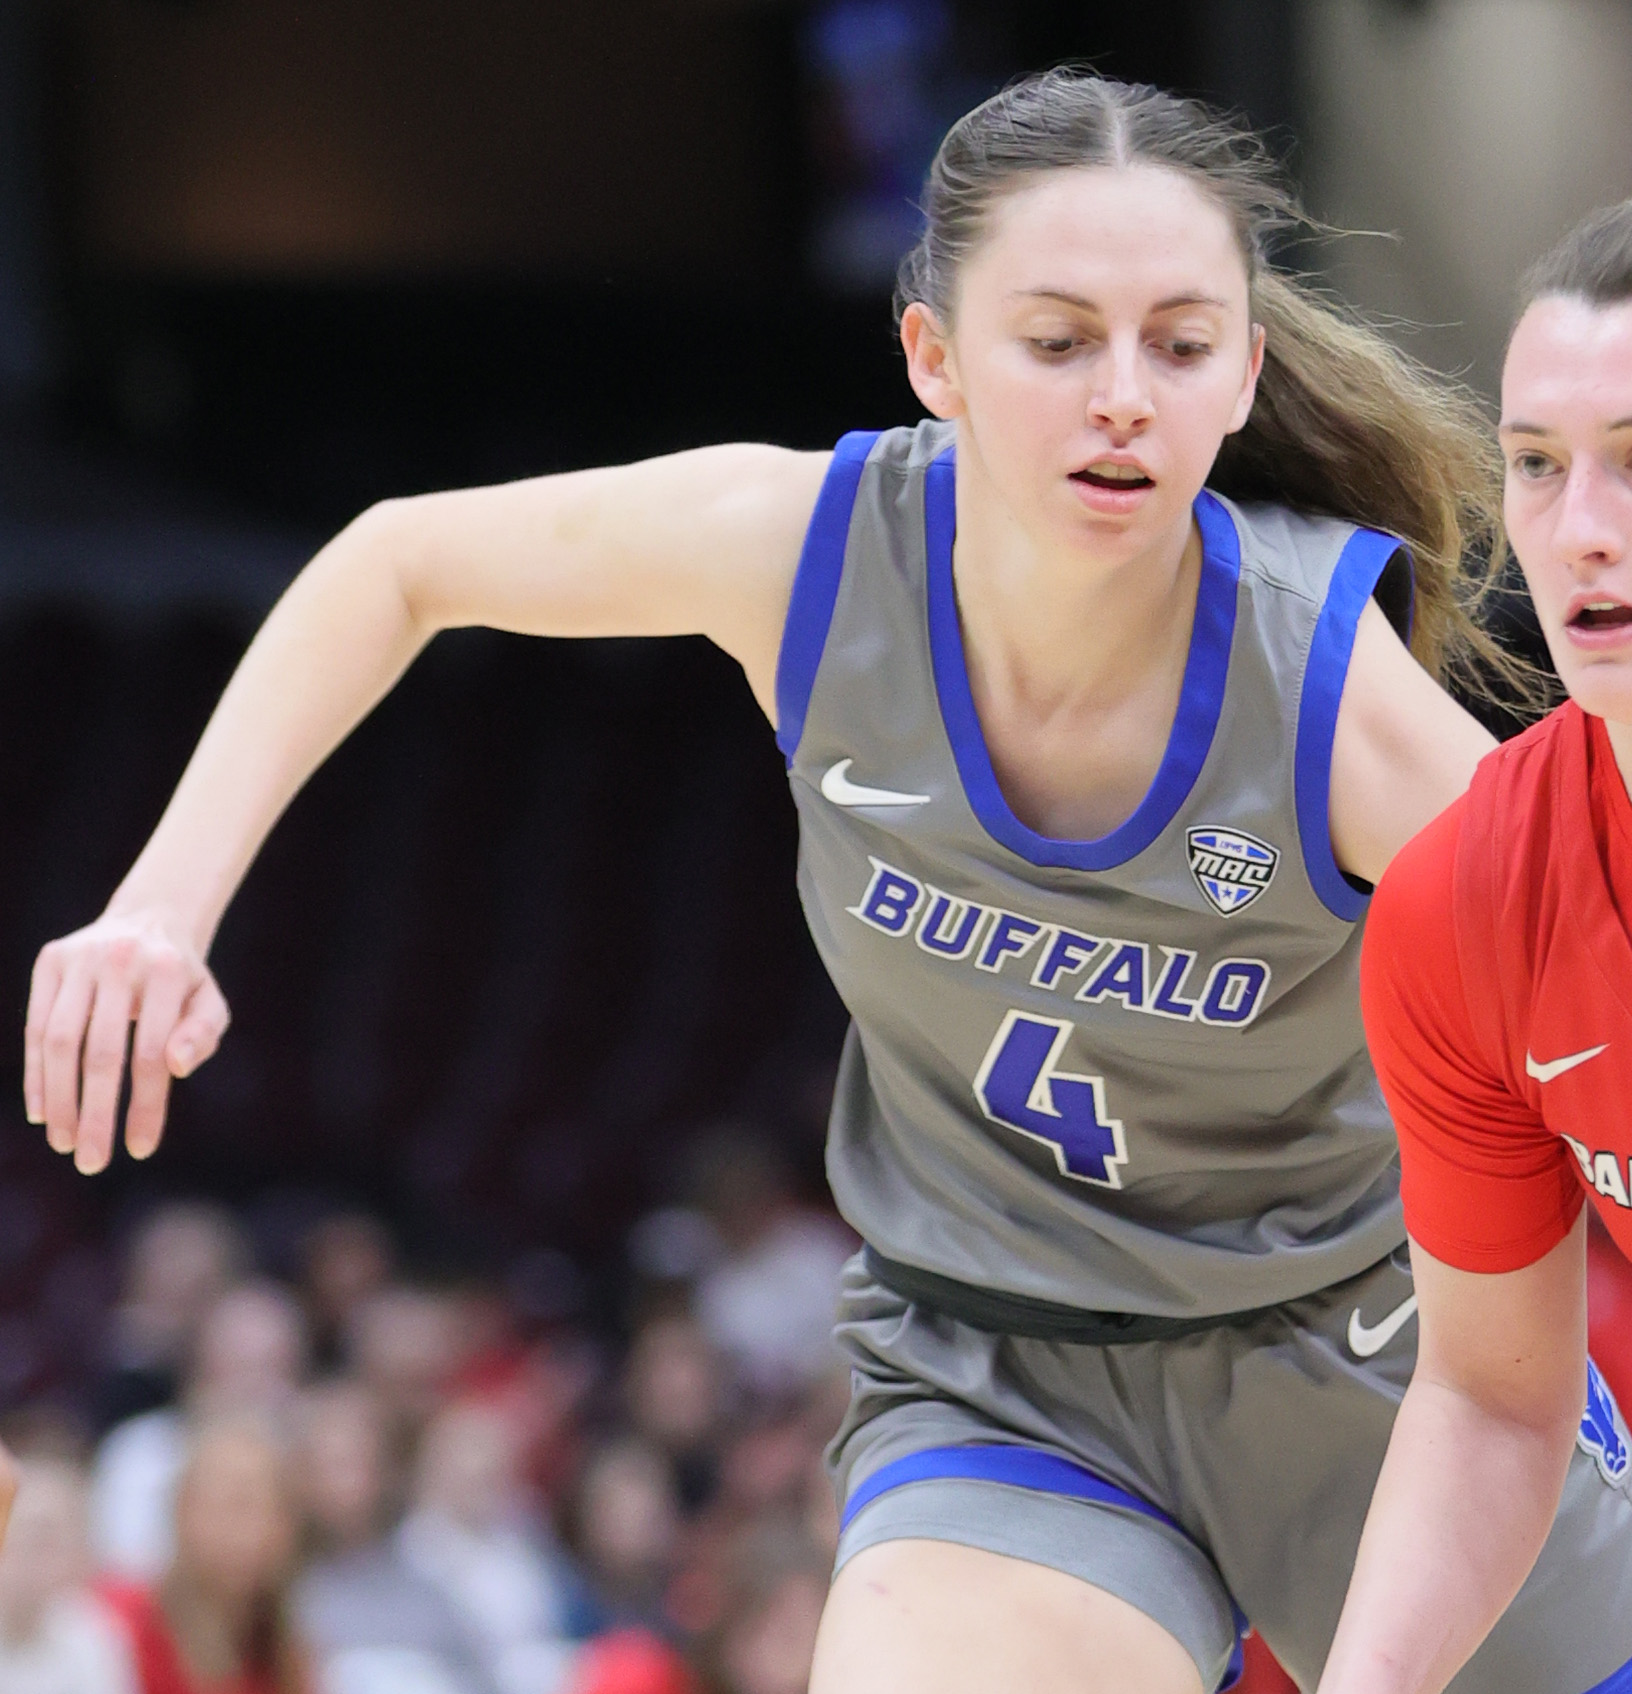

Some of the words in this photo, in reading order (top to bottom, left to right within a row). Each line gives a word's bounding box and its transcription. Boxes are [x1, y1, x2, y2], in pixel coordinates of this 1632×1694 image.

[845, 855, 1271, 1028] BUFFALO
[1190, 848, 1271, 887] MAC
[972, 1008, 1129, 1190] 4
